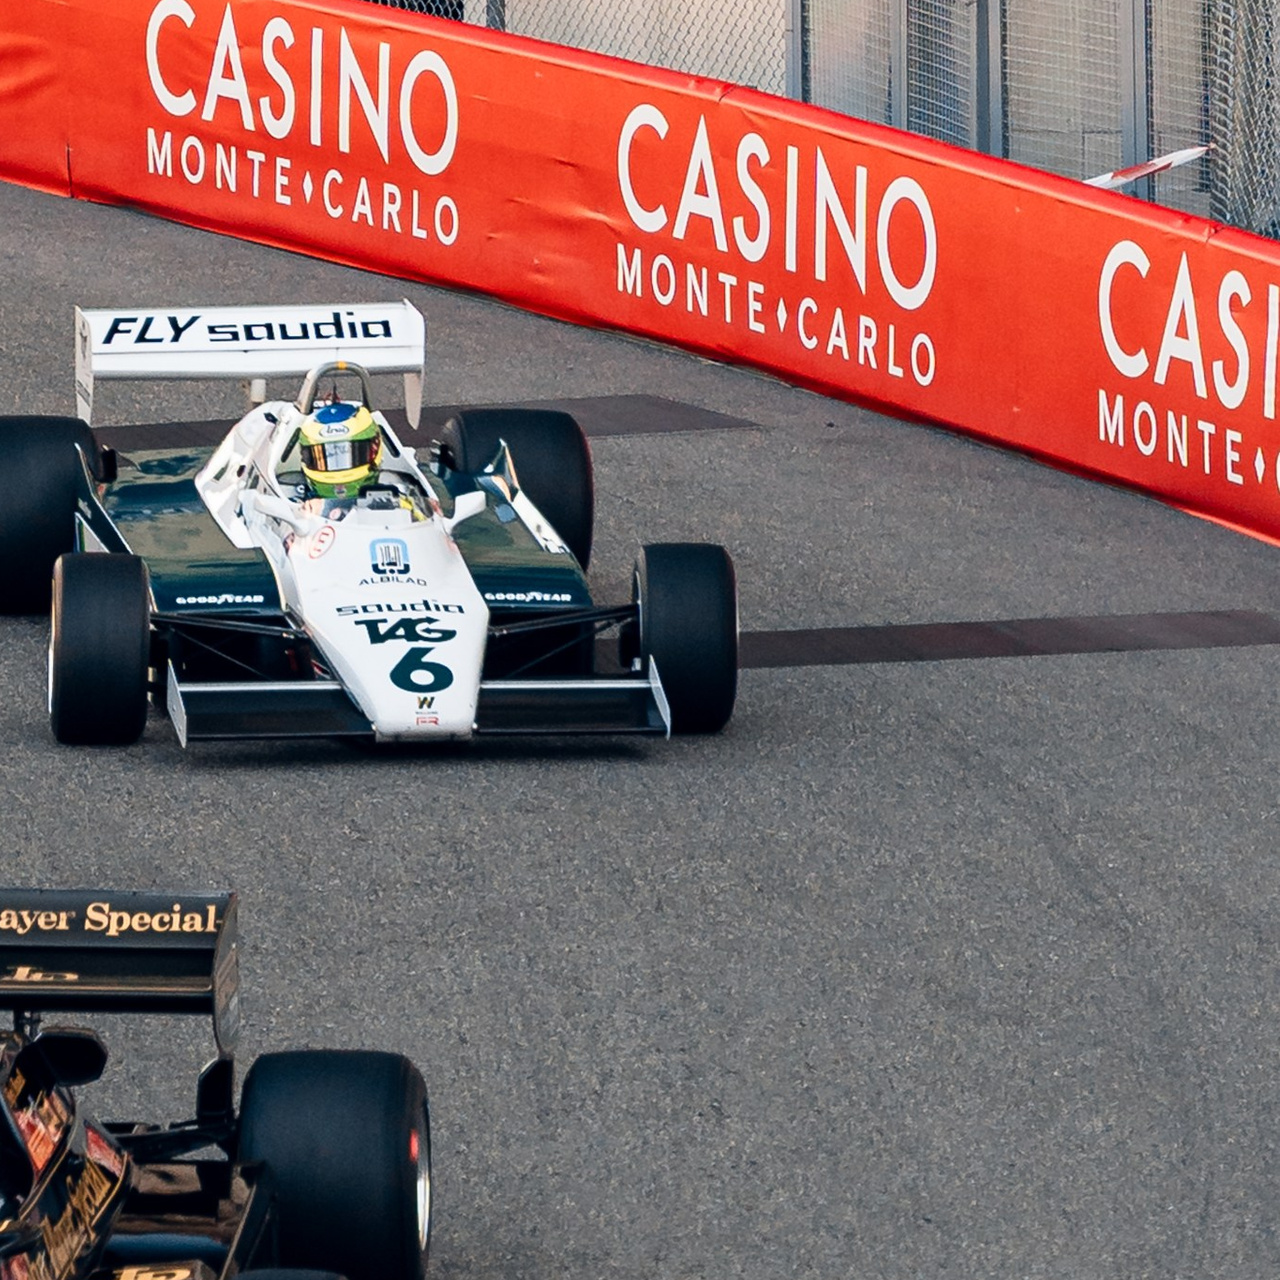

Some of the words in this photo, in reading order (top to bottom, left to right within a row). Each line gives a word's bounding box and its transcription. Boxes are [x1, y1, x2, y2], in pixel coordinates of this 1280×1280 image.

[617, 104, 937, 311] CASINO
[101, 314, 201, 345] FLY
[208, 311, 394, 343] saudia
[1098, 389, 1244, 485] MONTE
[358, 575, 428, 587] ALBILAD
[484, 591, 572, 602] GOODYEAR
[176, 593, 264, 605] GOODYEAR
[335, 598, 466, 616] saudia
[389, 646, 454, 694] 6
[84, 902, 218, 936] Special
